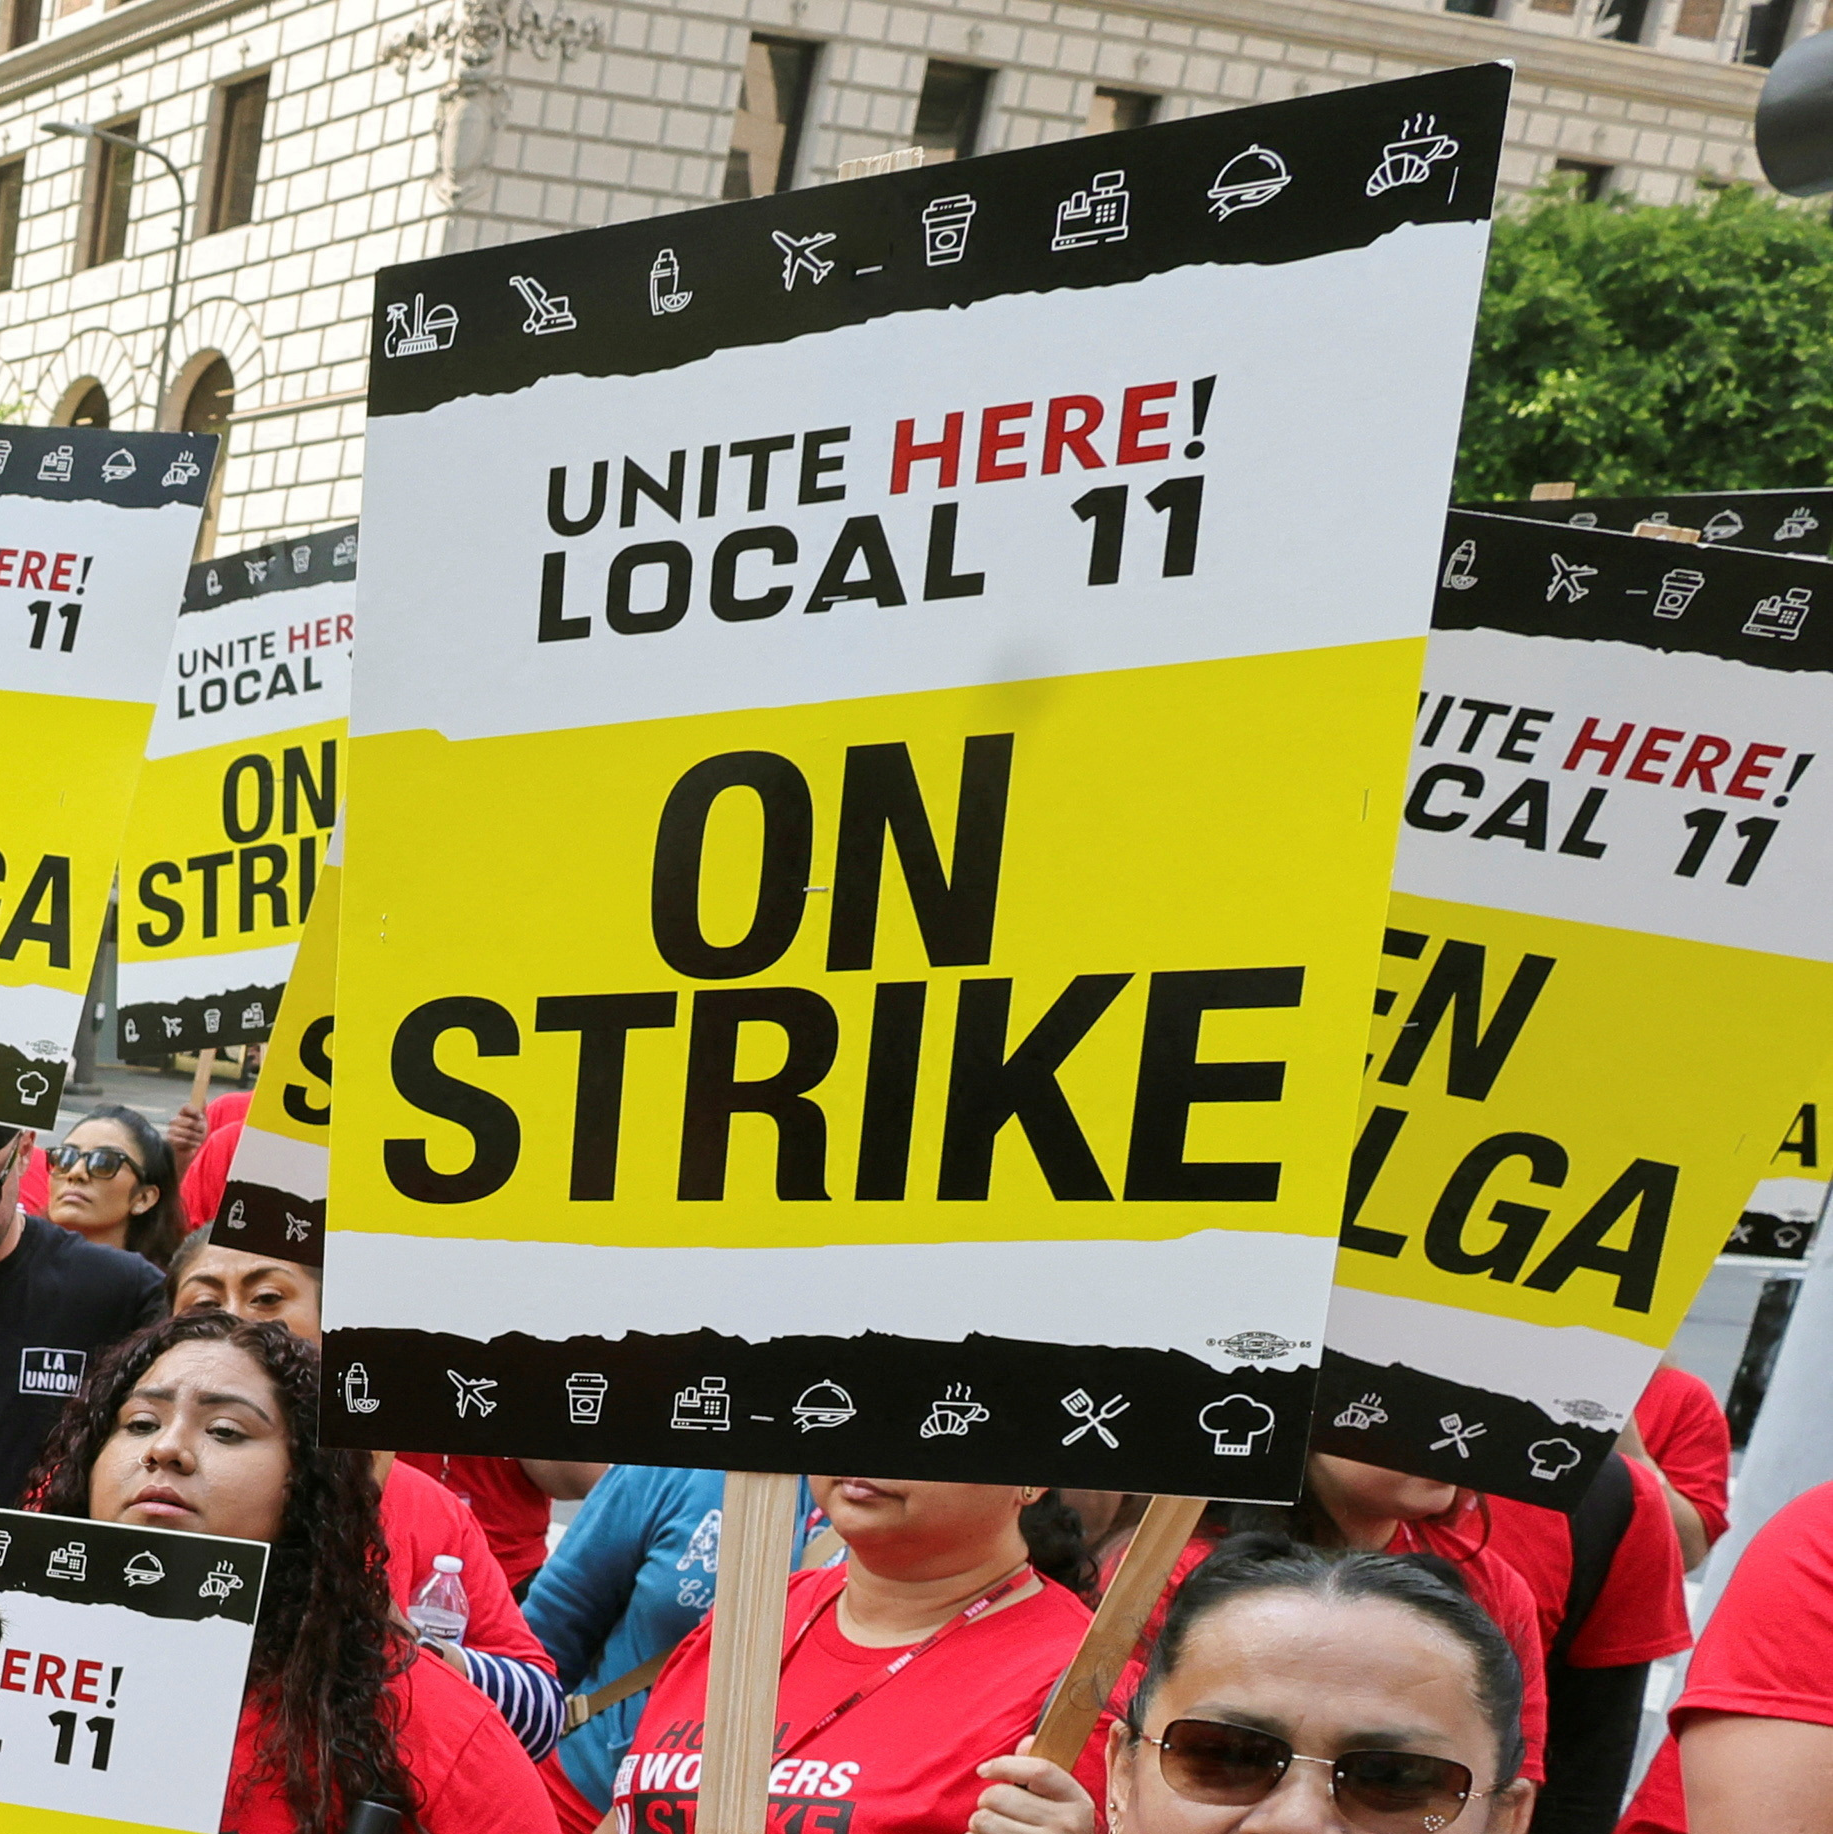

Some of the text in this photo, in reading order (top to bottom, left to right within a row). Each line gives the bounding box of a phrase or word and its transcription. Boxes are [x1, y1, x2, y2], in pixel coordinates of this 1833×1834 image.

[546, 375, 1218, 538] UNITE HERE!
[536, 474, 1206, 644] LOCAL 11
[27, 599, 83, 653] 11
[178, 631, 276, 679] UNITE
[177, 656, 323, 719] LOCAL
[222, 739, 337, 845] ON
[1561, 715, 1815, 808] HERE!
[649, 732, 1015, 981] ON
[1402, 762, 1780, 888] CAL 11
[137, 833, 332, 948] STRI
[382, 967, 1305, 1205] STRIKE
[1340, 1105, 1681, 1316] LGA
[24, 1369, 79, 1393] UNION
[40, 1349, 66, 1370] LA
[0, 1648, 124, 1710] ERE!
[49, 1710, 115, 1772] 11
